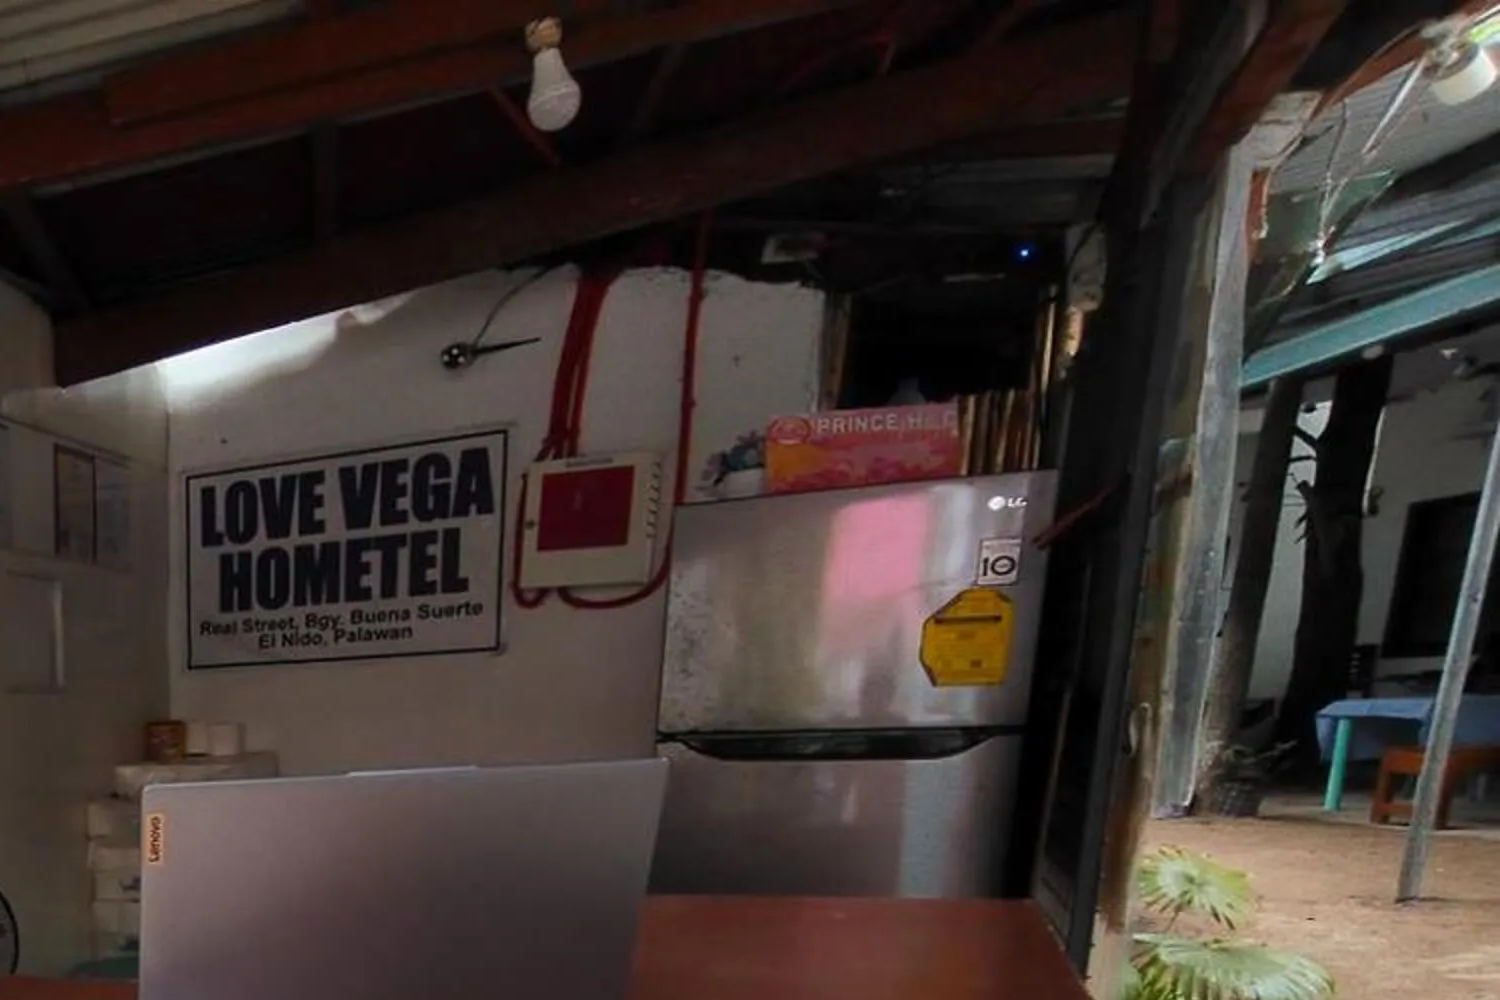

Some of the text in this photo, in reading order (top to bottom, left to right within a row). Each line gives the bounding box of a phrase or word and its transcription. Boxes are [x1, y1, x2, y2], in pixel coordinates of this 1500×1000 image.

[816, 413, 898, 434] PRINCE
[201, 447, 495, 548] LOVE VEGA
[219, 527, 469, 613] HOMETEL
[200, 619, 238, 637] Real
[242, 616, 300, 635] Street,
[351, 606, 411, 625] Buena
[417, 601, 484, 620] Suerte
[259, 626, 413, 649] El Nido, Palawan
[147, 815, 161, 863] Lenovo
